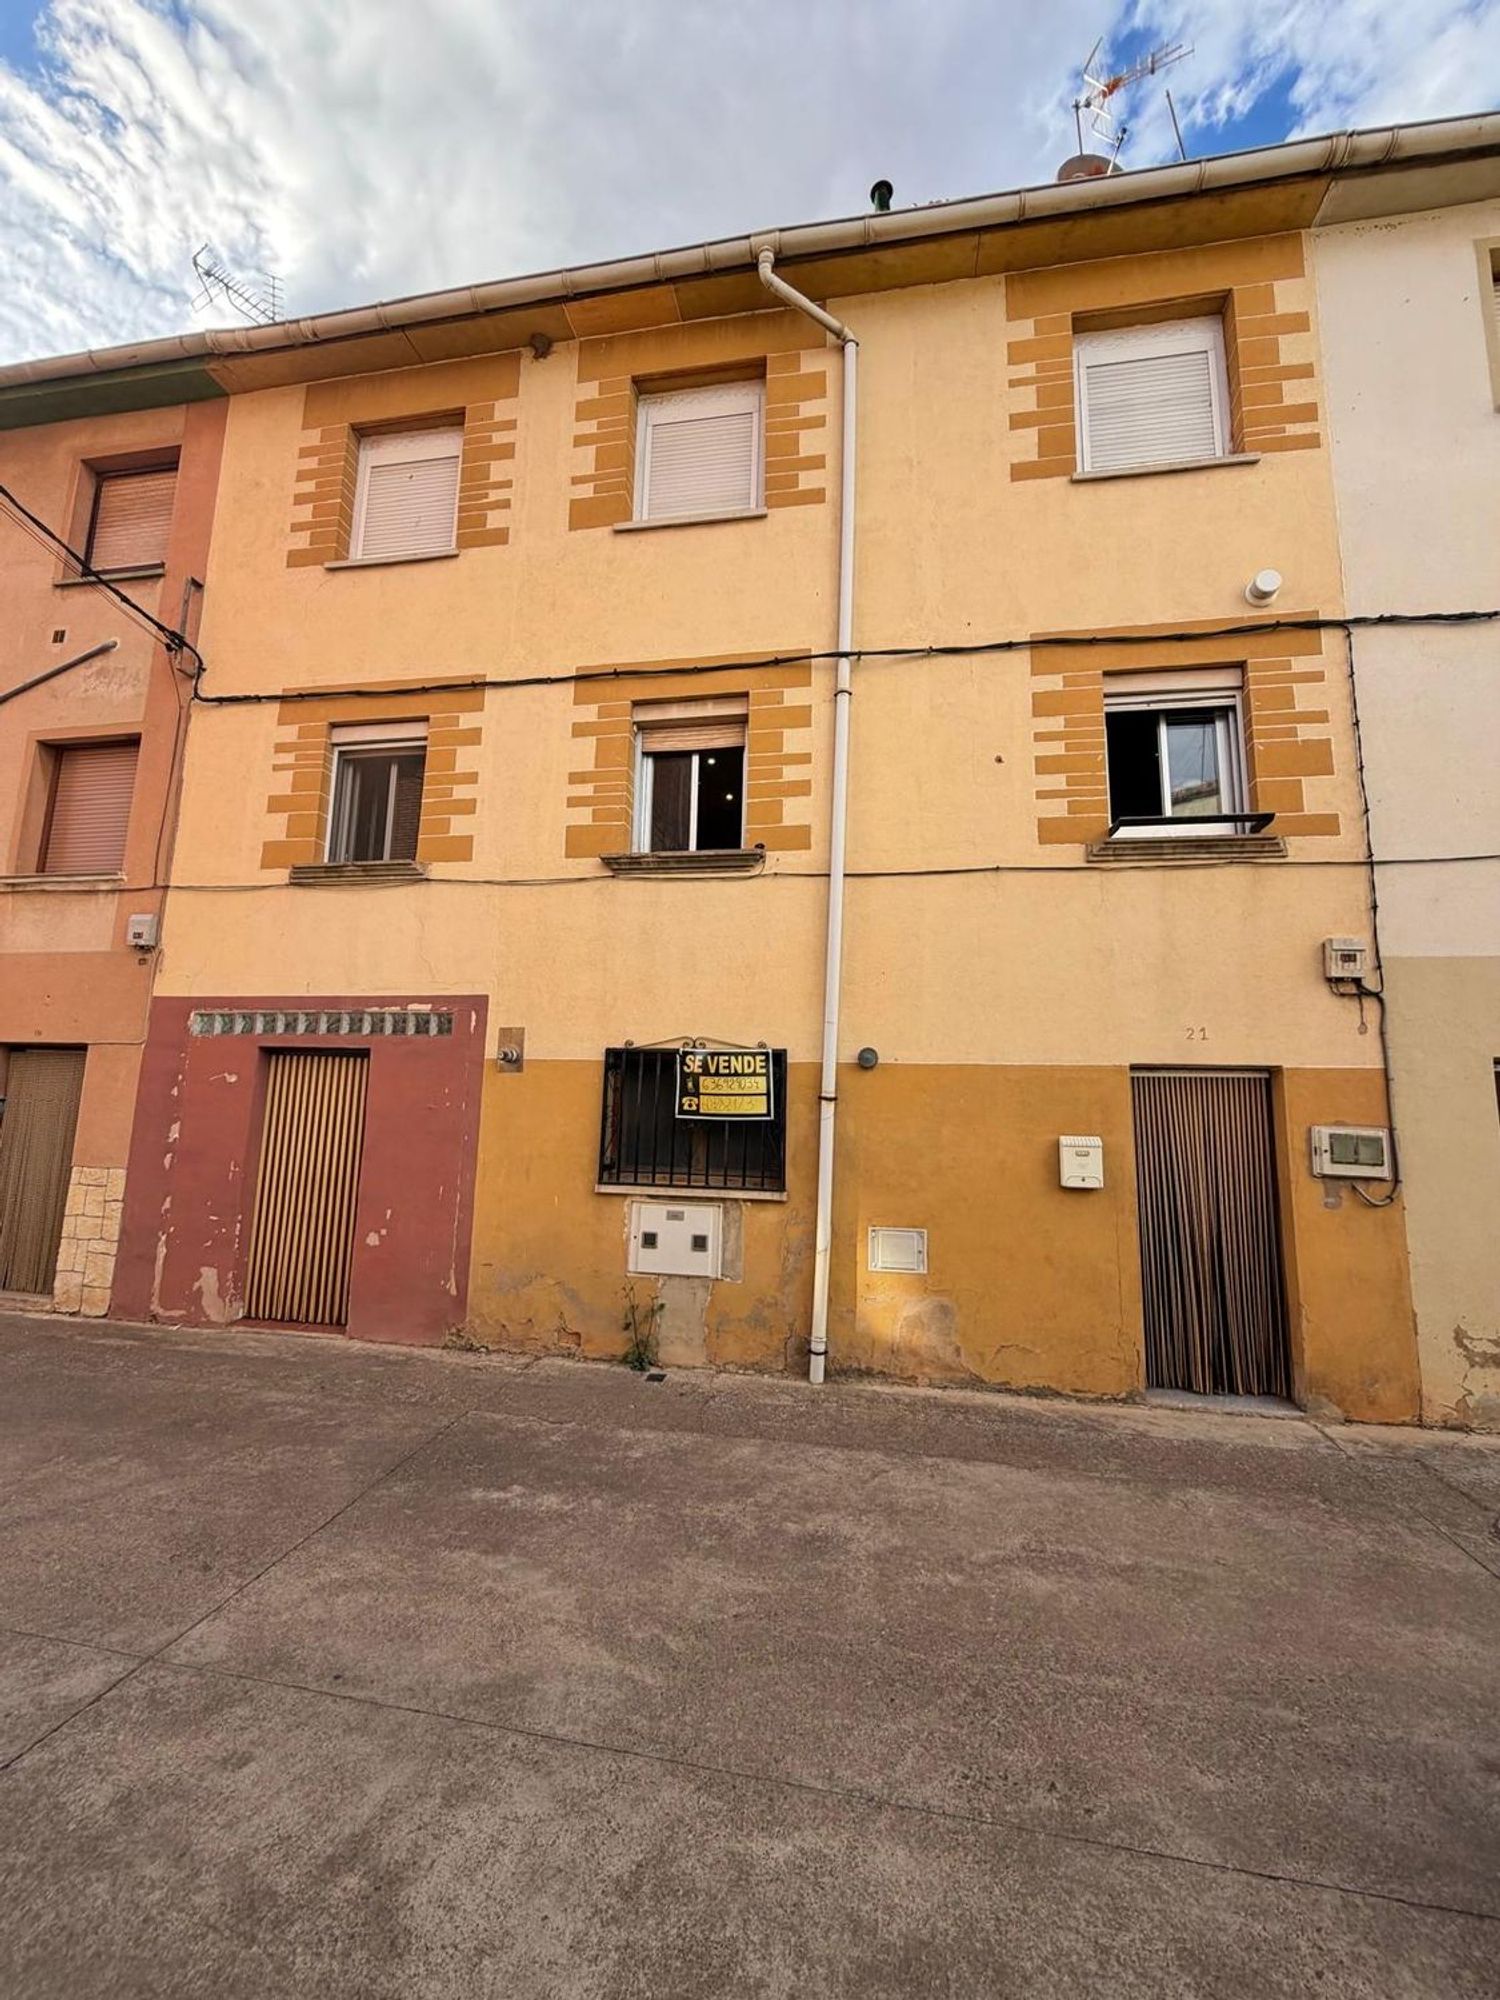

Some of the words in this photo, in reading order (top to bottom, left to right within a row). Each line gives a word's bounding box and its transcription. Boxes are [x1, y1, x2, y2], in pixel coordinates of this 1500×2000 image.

[1186, 1026, 1210, 1041] 21
[683, 1054, 703, 1073] SE
[707, 1055, 767, 1074] VENDE
